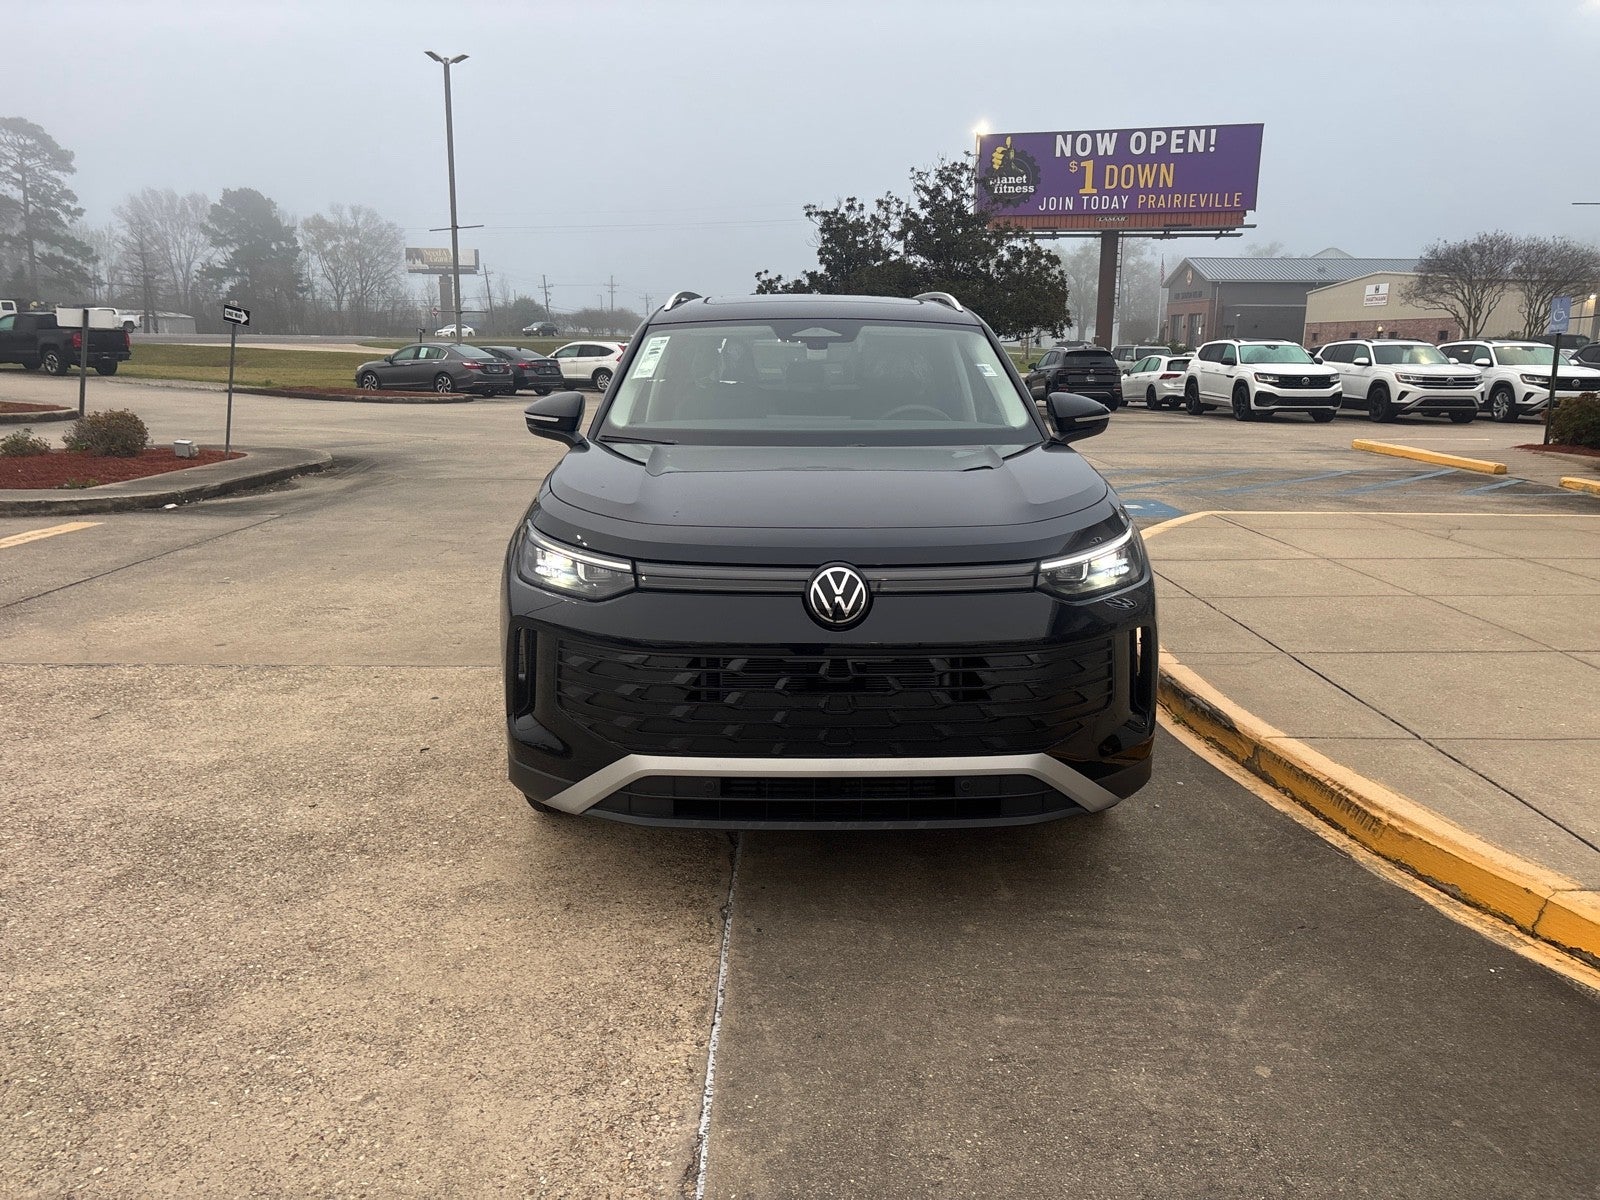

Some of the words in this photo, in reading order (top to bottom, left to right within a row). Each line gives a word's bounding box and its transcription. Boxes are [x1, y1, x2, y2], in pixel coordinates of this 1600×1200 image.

[1055, 132, 1118, 157] NOW
[1129, 128, 1217, 154] OPEN!
[1104, 163, 1175, 190] DOWN
[1038, 196, 1074, 211] JOIN
[1081, 195, 1129, 210] TODAY
[1137, 192, 1243, 209] PRAIRIEVILLE
